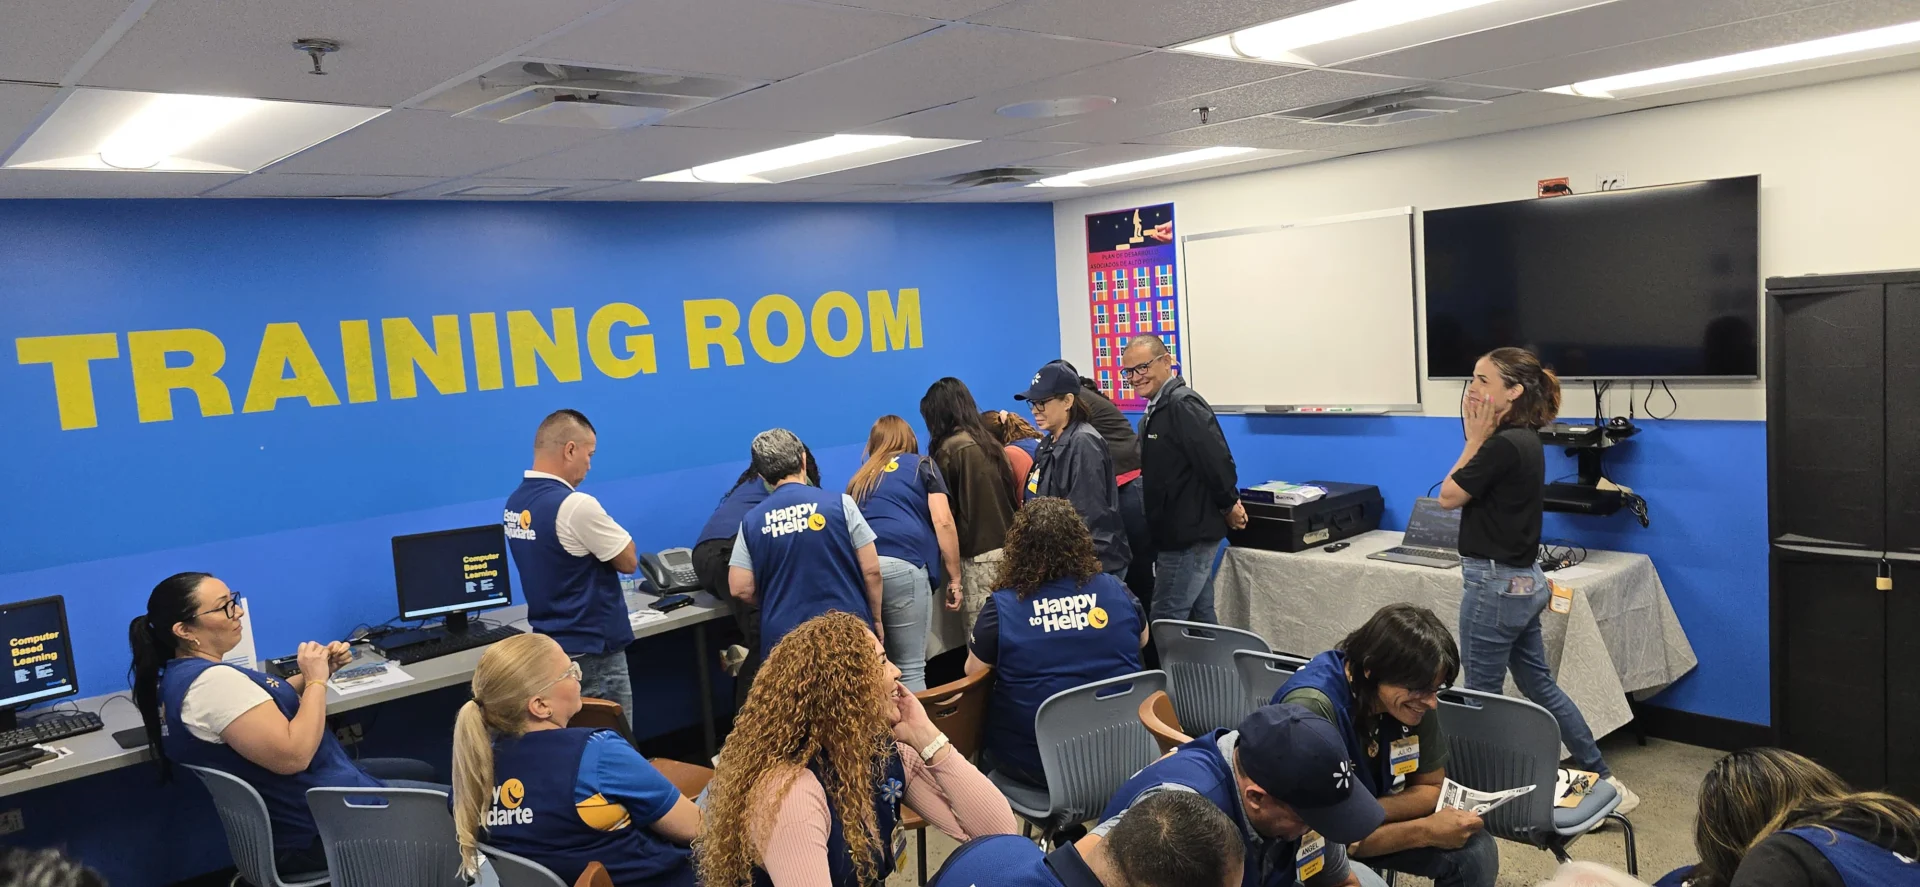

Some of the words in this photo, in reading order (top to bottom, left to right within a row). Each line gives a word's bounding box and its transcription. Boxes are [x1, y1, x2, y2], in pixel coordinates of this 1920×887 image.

[1090, 261, 1119, 270] ASOCIADOS
[18, 304, 656, 428] TRAINING
[685, 290, 922, 369] ROOM
[765, 502, 818, 525] Happy
[761, 525, 772, 535] to
[771, 516, 809, 538] Help
[463, 553, 499, 563] Computer
[464, 562, 487, 571] Based
[465, 570, 497, 579] Learning
[1032, 593, 1097, 616] Happy
[1028, 616, 1042, 627] to
[1042, 610, 1090, 633] Help
[10, 632, 59, 646] Computer
[12, 643, 43, 656] Based
[13, 652, 57, 666] Learning
[487, 806, 533, 826] darte
[1301, 842, 1320, 857] ANGEL
